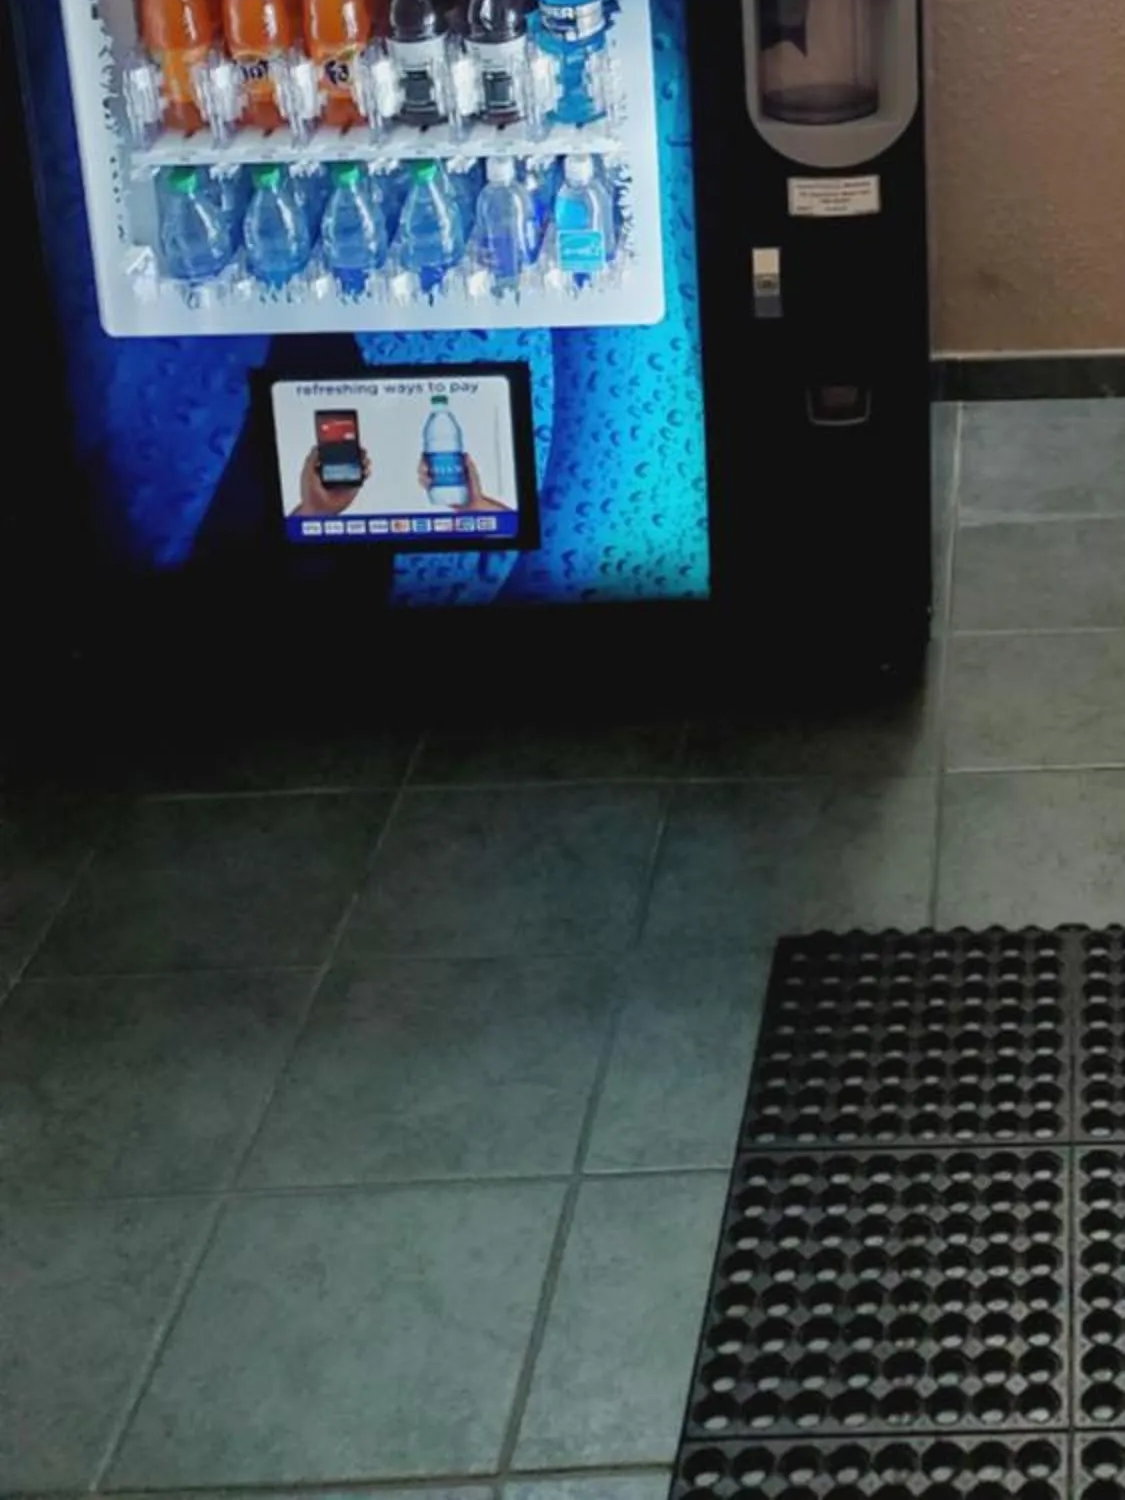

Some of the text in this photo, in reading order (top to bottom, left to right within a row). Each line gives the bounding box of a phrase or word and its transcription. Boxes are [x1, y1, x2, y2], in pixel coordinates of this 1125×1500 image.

[296, 380, 480, 397] refreshing ways to pay
